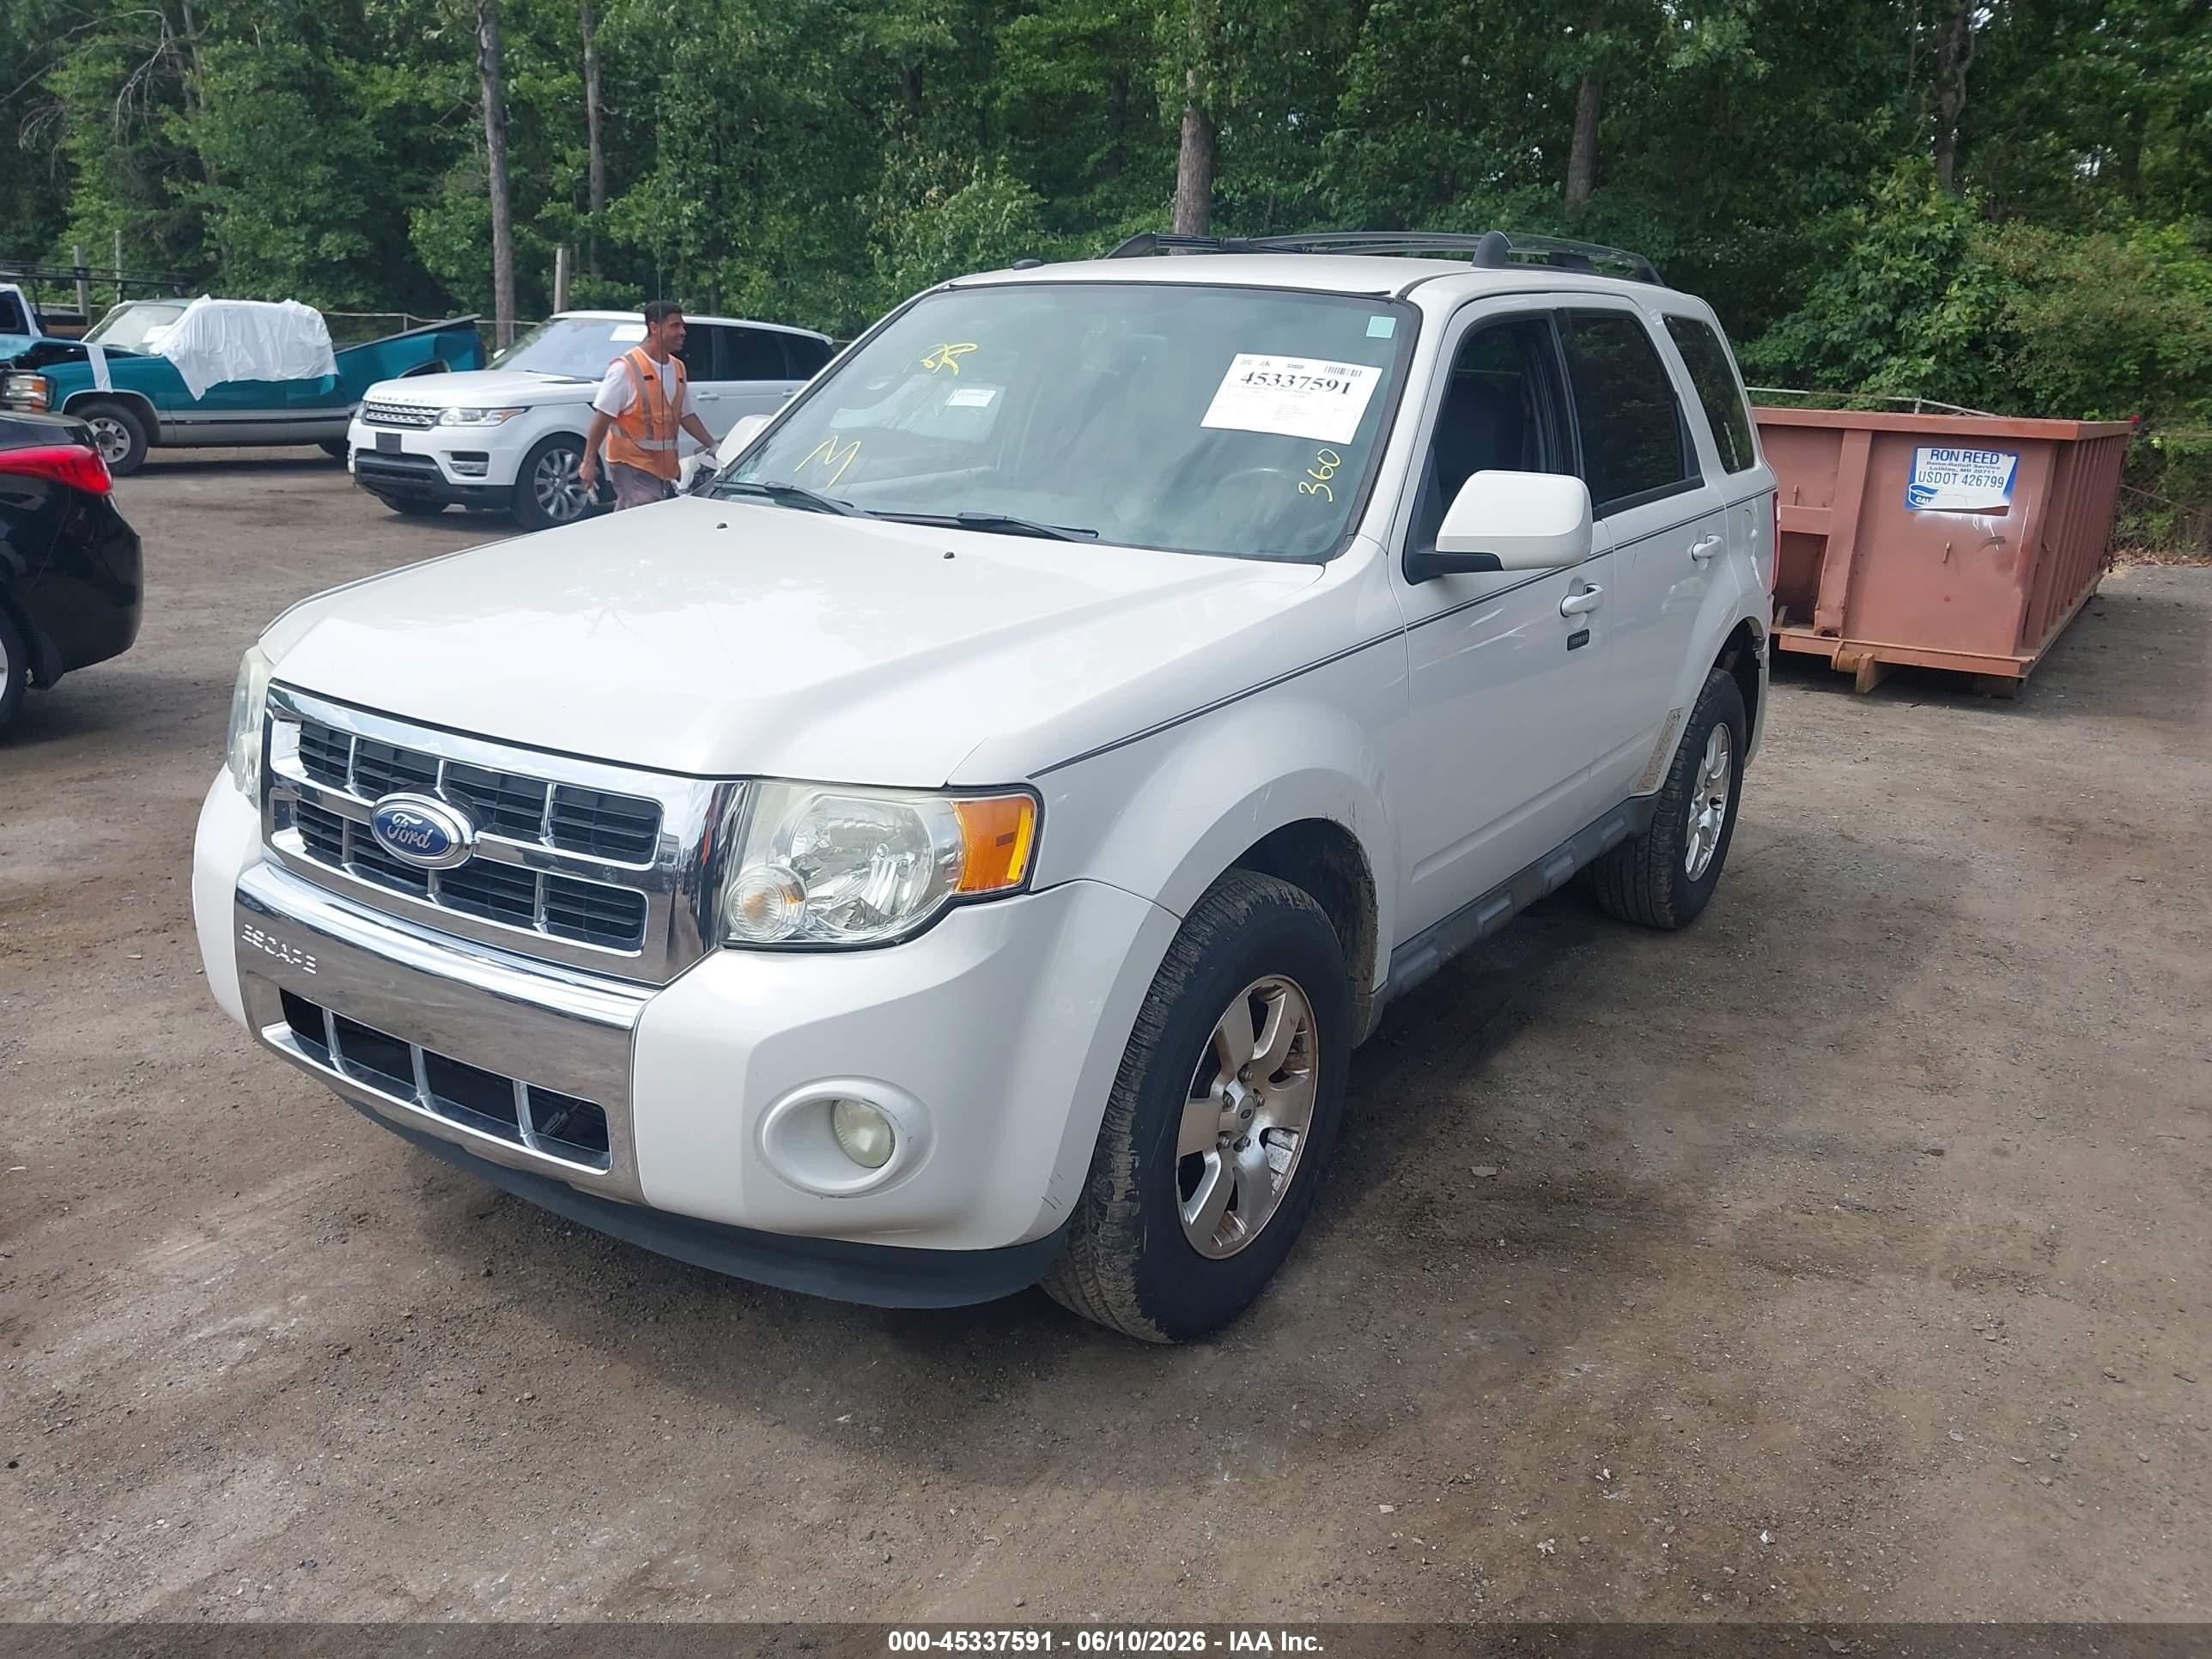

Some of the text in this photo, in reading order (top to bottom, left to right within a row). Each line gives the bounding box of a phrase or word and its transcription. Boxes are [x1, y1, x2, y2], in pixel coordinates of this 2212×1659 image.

[1240, 371, 1352, 396] 45337591
[1929, 449, 2000, 465] RON REED
[1297, 448, 1341, 502] 360
[1917, 471, 2005, 489] USDOT 426799
[386, 812, 434, 849] Ford
